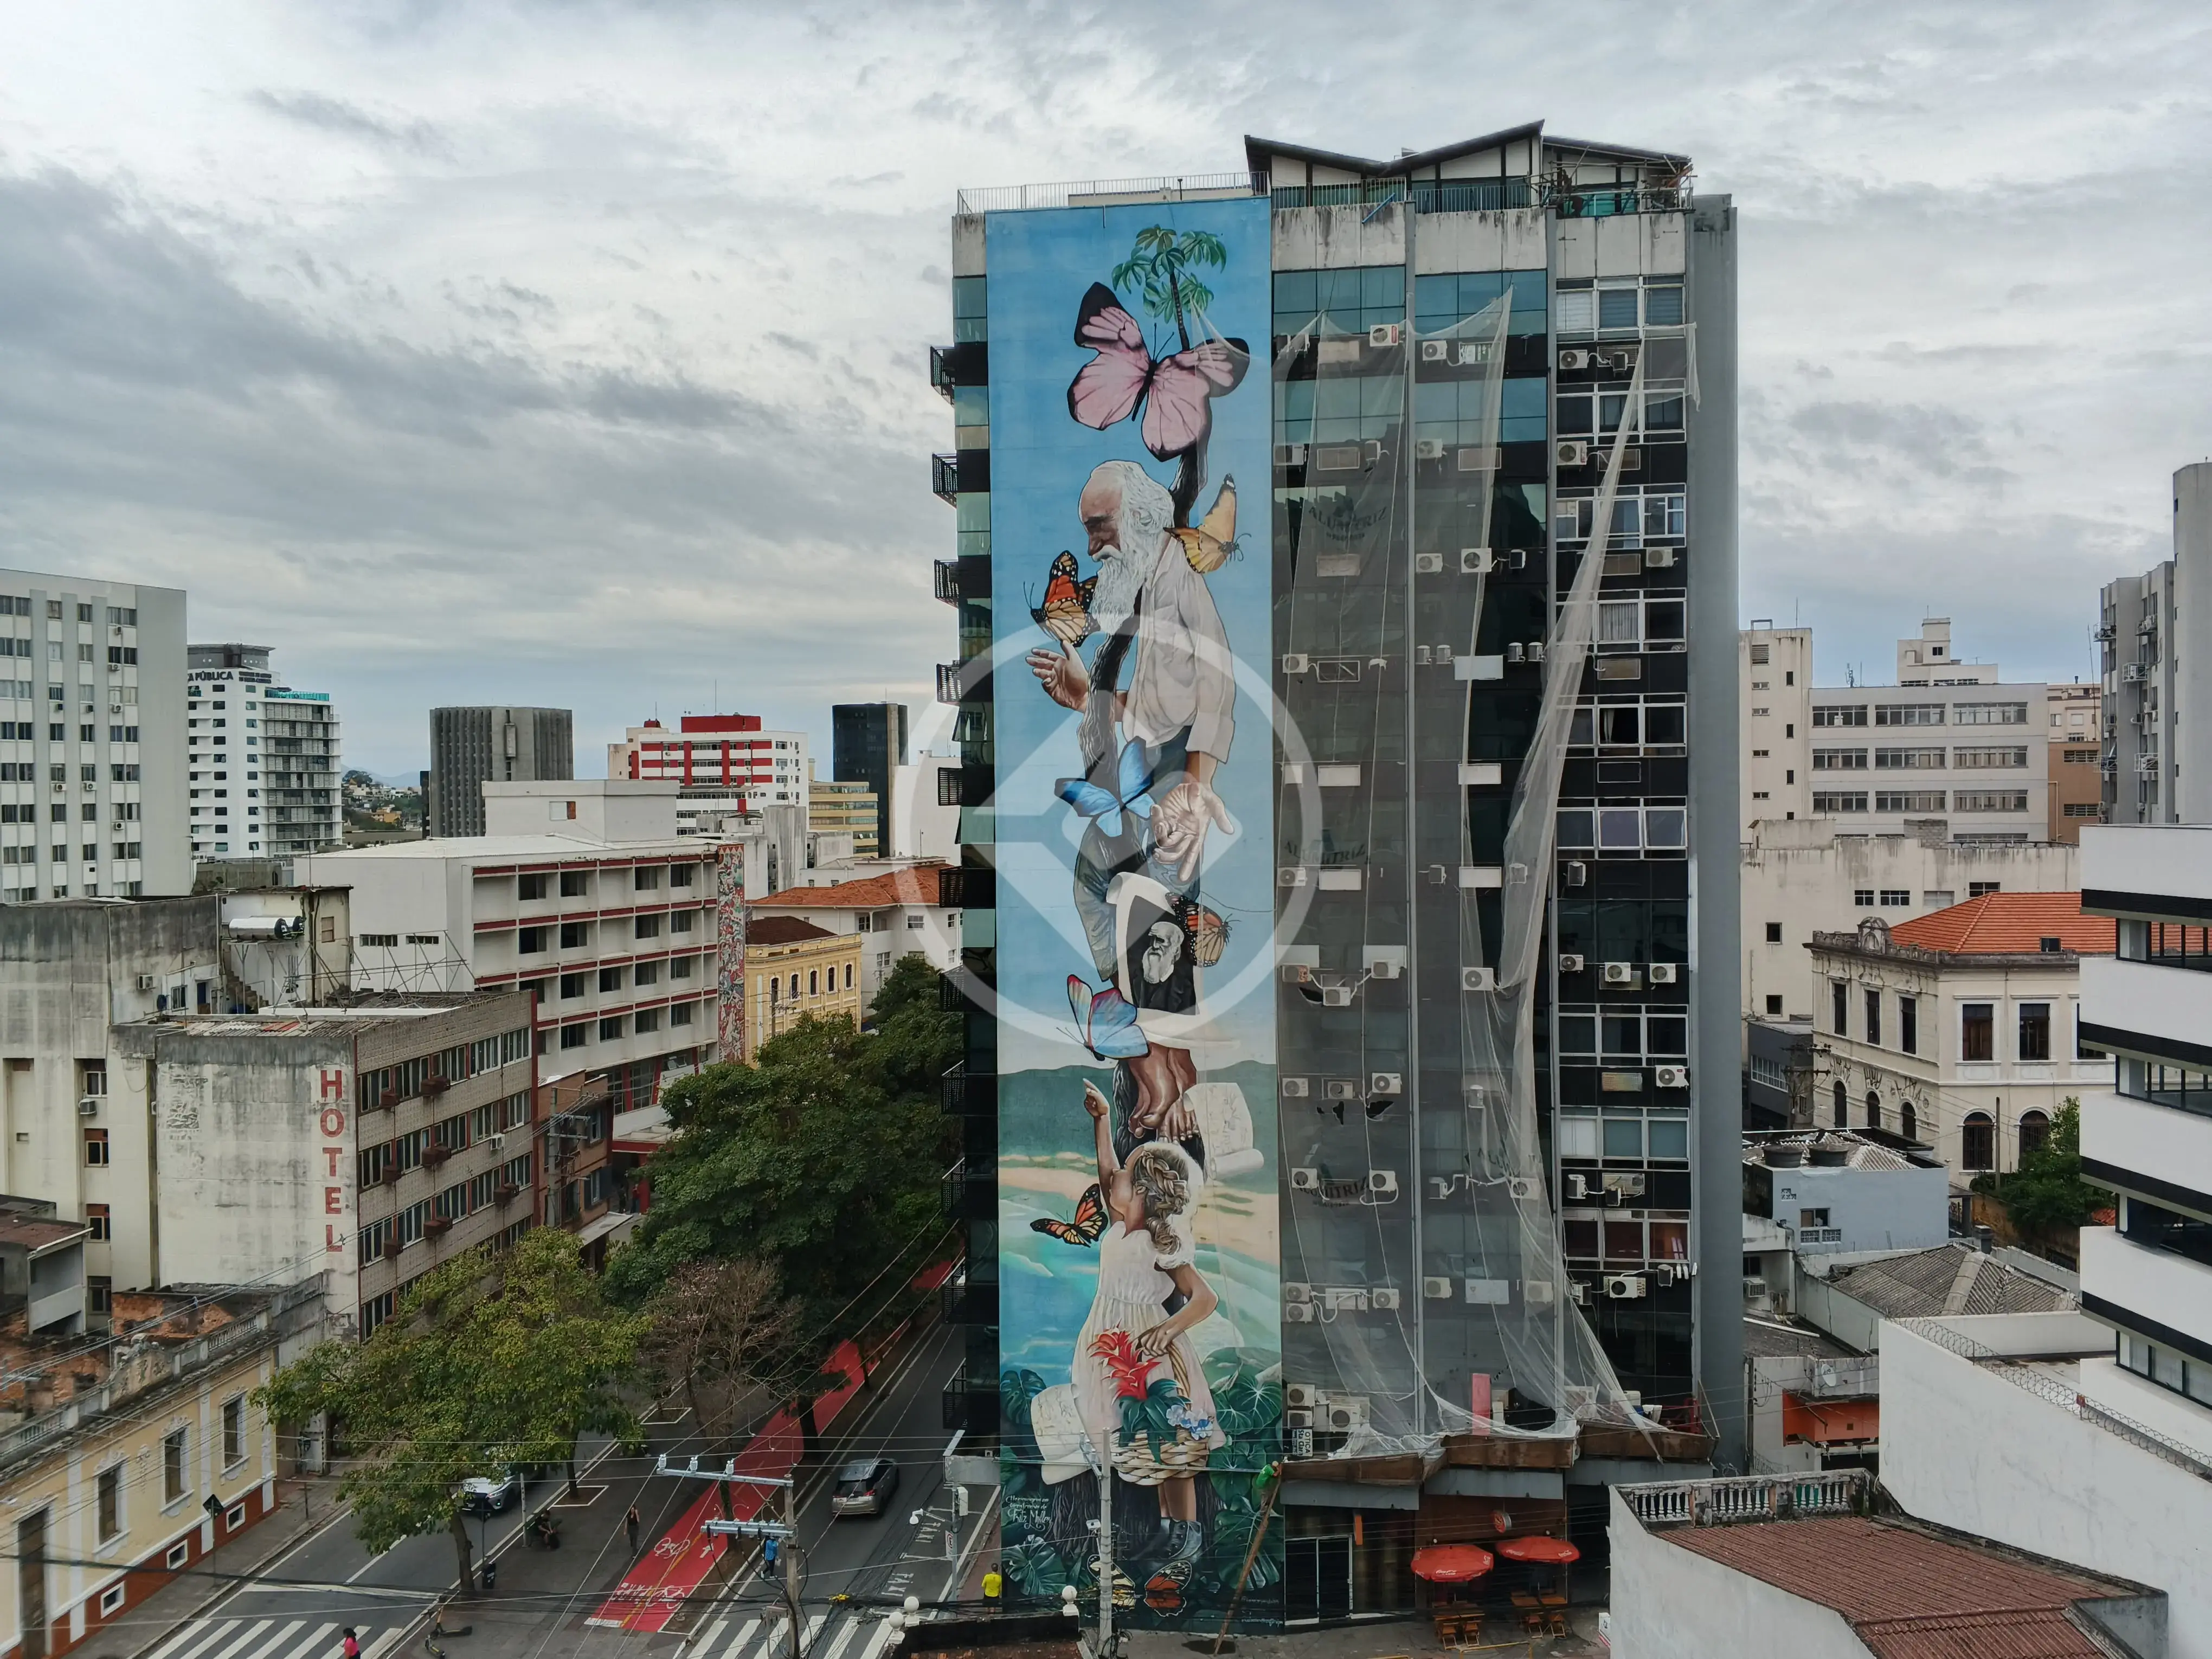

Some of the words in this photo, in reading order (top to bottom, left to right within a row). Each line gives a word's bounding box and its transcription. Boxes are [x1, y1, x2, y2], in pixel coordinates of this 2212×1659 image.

[195, 671, 234, 681] PÚBLICA
[320, 1070, 344, 1252] HOTEL
[881, 1573, 915, 1597] TÁXI
